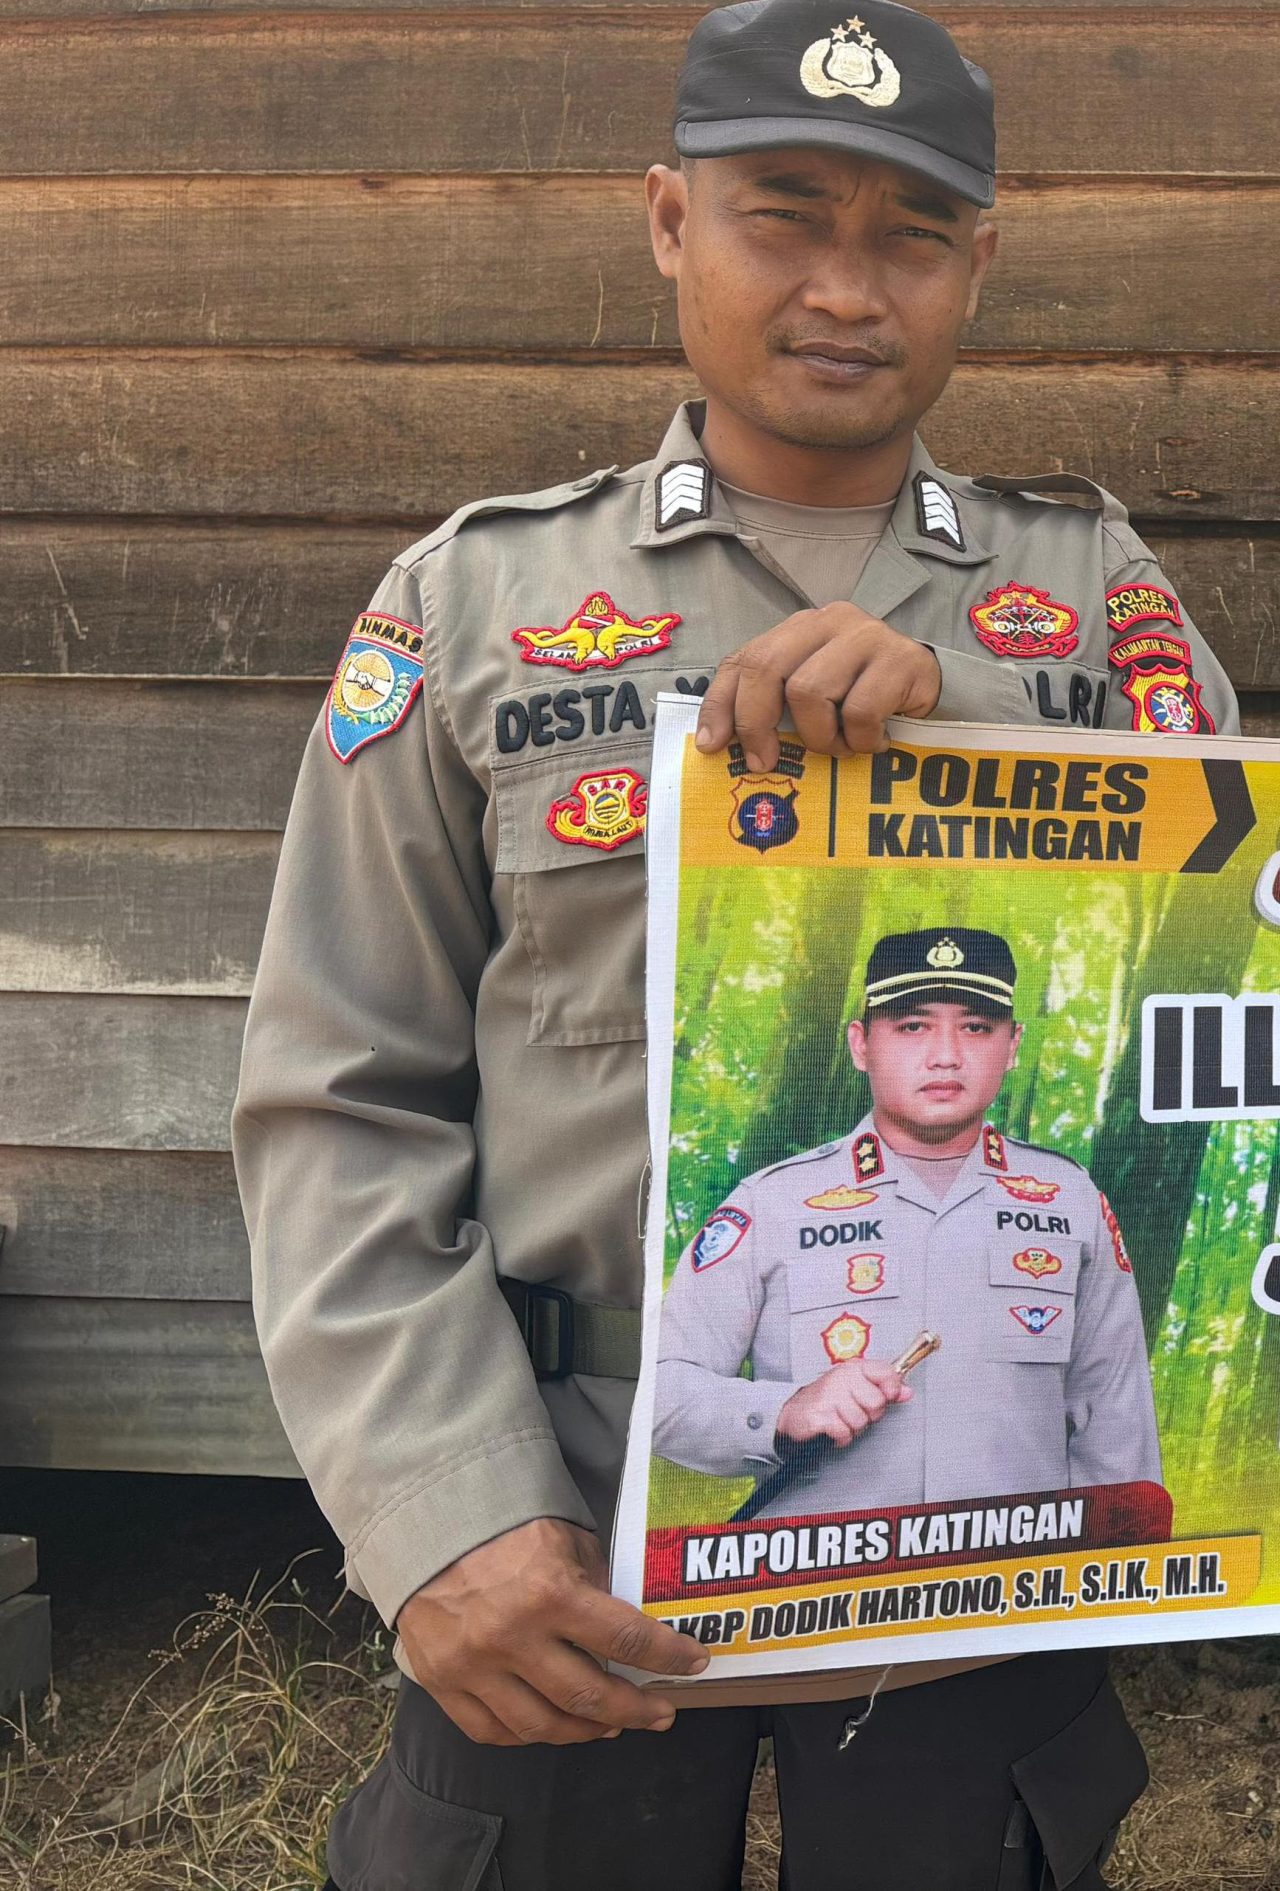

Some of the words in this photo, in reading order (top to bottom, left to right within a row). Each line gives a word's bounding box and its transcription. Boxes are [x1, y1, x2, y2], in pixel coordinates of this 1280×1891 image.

[1107, 589, 1168, 611] POLRES
[869, 750, 1148, 814] POLRES
[868, 813, 1141, 861] KATINGAN
[800, 1220, 884, 1250] DODIK
[997, 1211, 1071, 1235] POLRI
[685, 1519, 889, 1582] KAPOLRES
[900, 1499, 1085, 1558] KATINGAN
[750, 1592, 850, 1640] DODIK
[858, 1577, 1009, 1624] HARTONO,
[1015, 1569, 1075, 1610] S.H.,
[1165, 1554, 1224, 1595] M.H.
